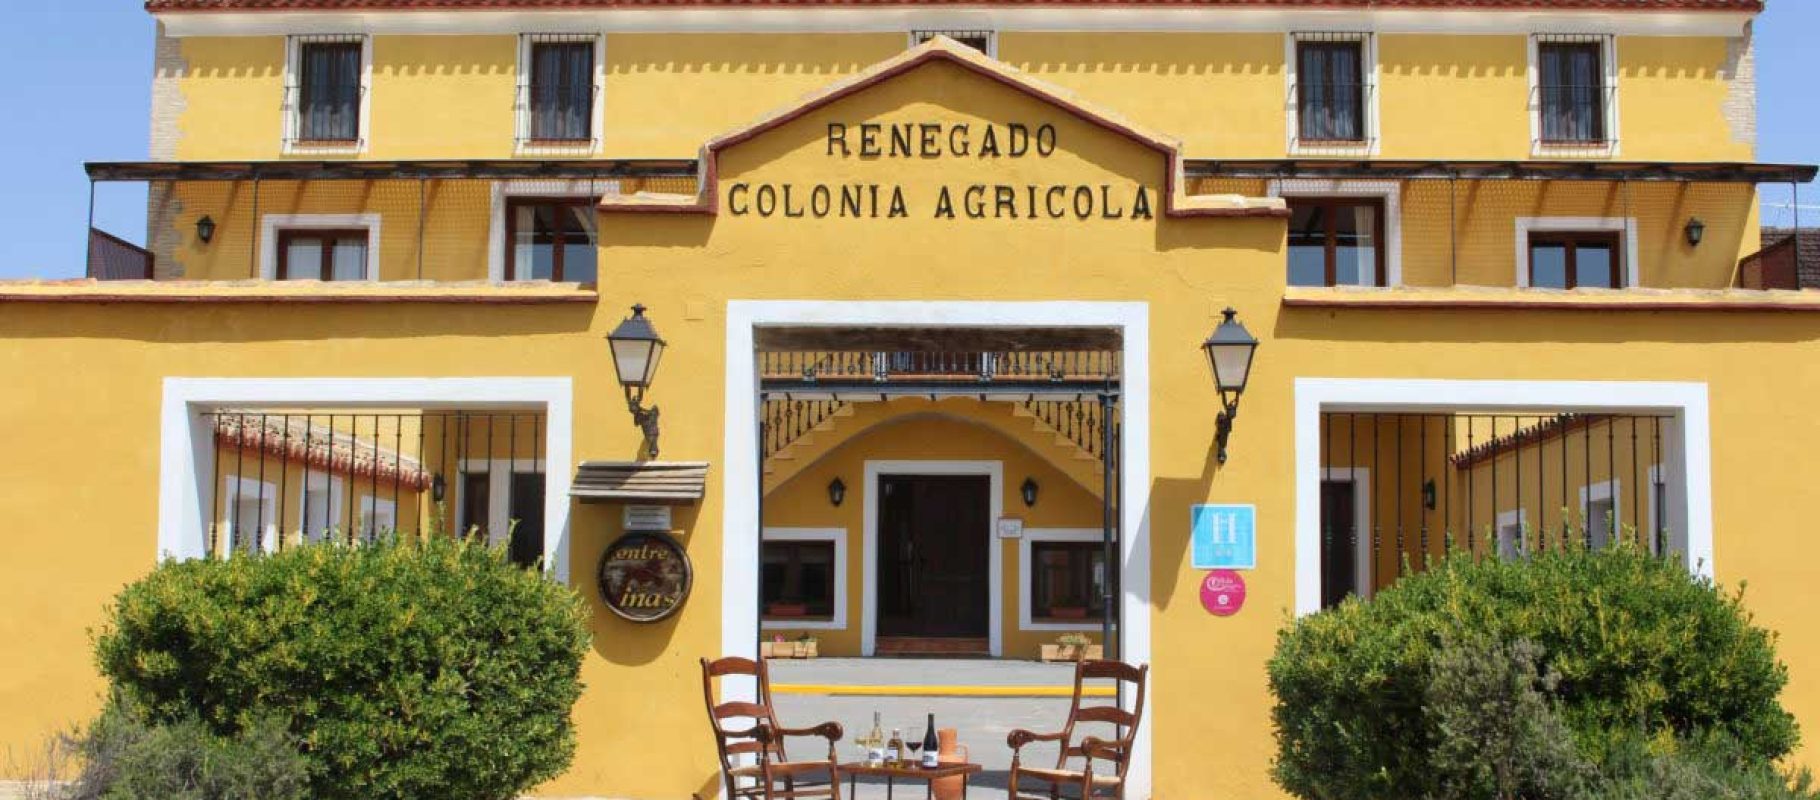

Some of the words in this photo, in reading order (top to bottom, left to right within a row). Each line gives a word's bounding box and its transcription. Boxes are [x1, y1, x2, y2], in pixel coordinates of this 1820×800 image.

[826, 122, 1057, 158] RENEGADO
[728, 183, 909, 219] COLONIA
[933, 184, 1153, 220] AGRICOLA
[1212, 512, 1236, 544] H
[616, 545, 668, 560] entre
